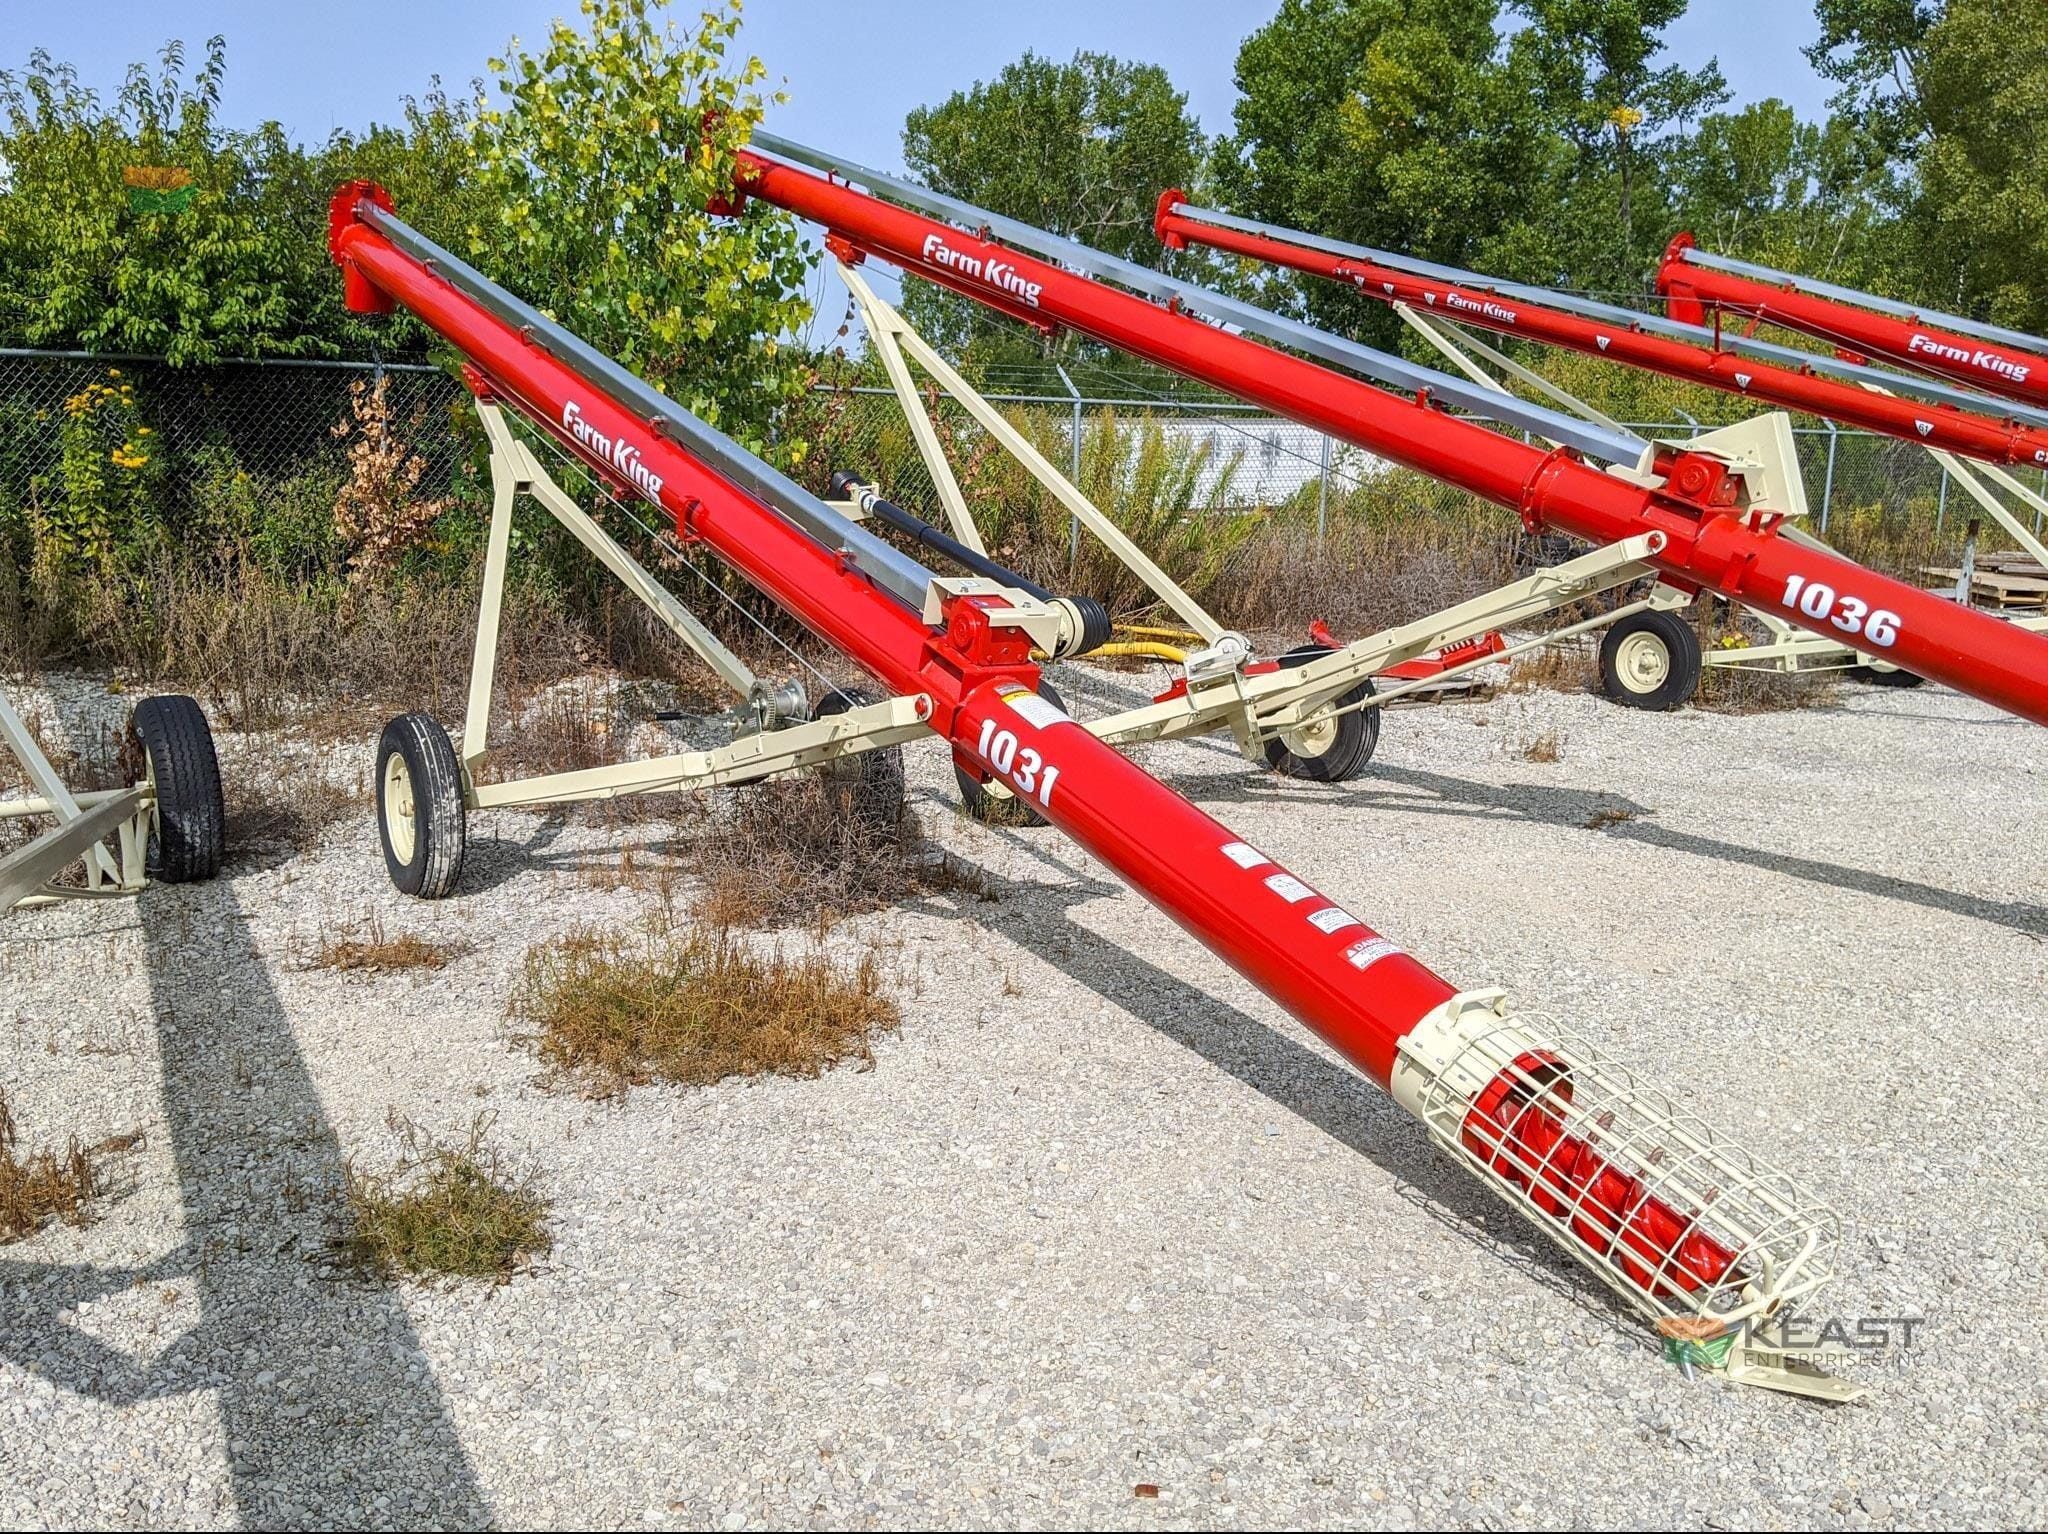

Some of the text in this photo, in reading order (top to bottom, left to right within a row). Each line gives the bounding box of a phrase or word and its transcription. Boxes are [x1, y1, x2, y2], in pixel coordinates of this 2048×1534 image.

[922, 233, 1043, 309] Farm King
[1446, 292, 1518, 324] Farm King
[1909, 333, 2031, 383] Farm King
[562, 400, 664, 507] Farm King
[2034, 450, 2048, 462] C
[1781, 573, 1903, 648] 1036
[978, 718, 1061, 808] 1031
